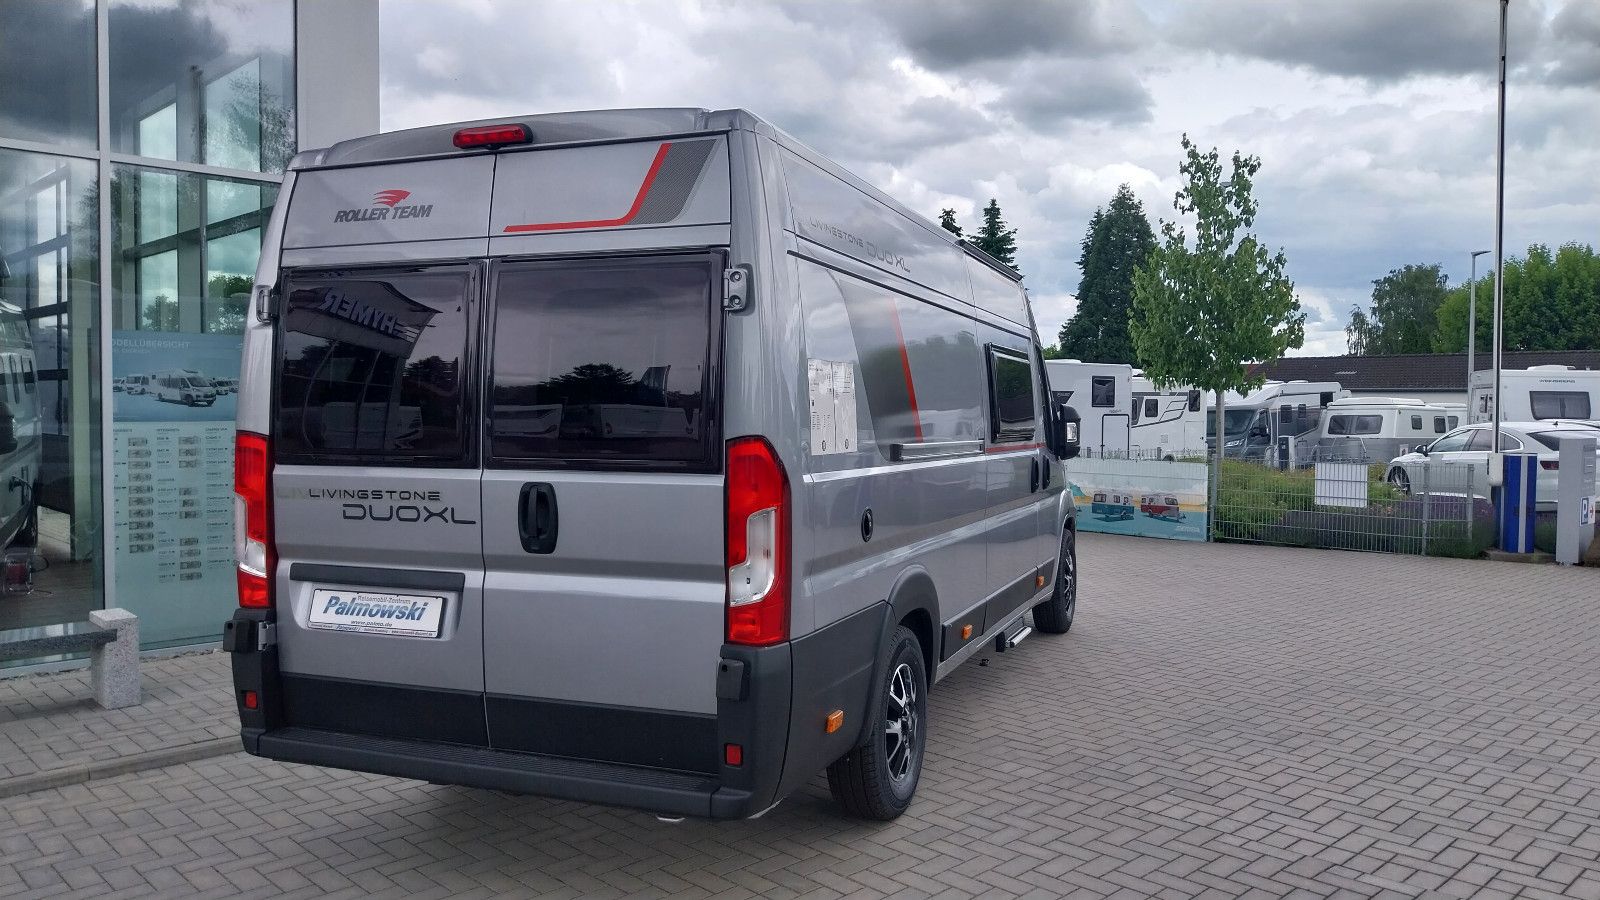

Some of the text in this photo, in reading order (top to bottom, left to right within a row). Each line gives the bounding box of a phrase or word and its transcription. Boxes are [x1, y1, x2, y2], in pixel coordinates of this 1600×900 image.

[334, 204, 433, 223] ROLLER TEAM
[810, 217, 864, 248] LIVINGSTONE
[309, 488, 441, 501] LIVINGSTONE
[342, 503, 476, 524] DUOXL
[323, 595, 429, 621] Palmowski
